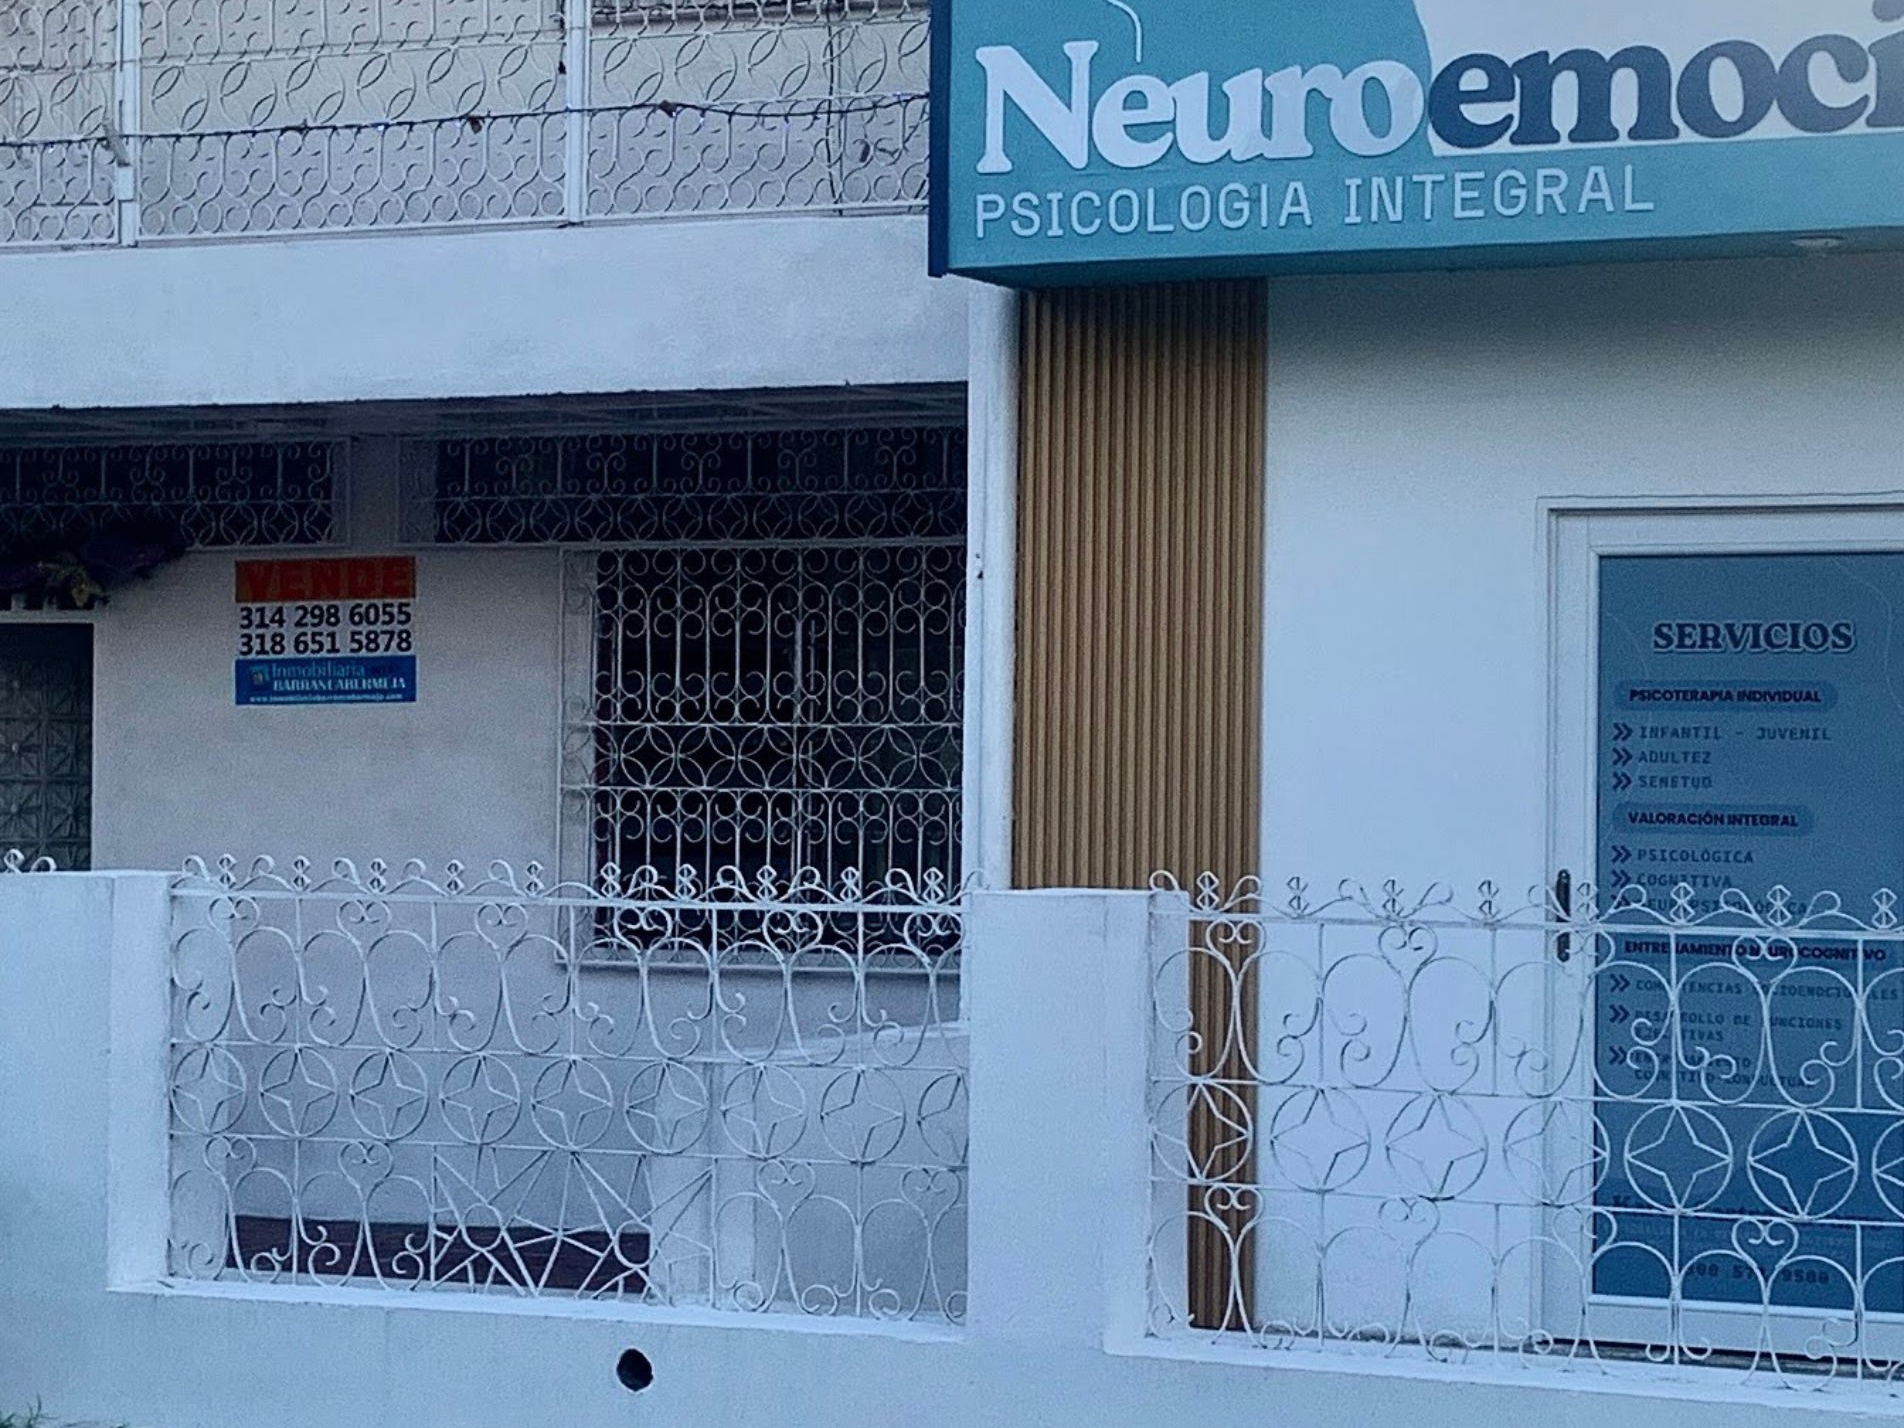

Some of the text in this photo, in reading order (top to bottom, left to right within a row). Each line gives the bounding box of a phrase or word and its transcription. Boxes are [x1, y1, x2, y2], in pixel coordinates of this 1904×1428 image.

[1342, 162, 1656, 227] INTEGRAL
[239, 601, 412, 630] 314 298 6055
[239, 628, 412, 657] 318 651 5878
[1653, 622, 1854, 651] SERVICIOS
[1629, 688, 1822, 703] PSICOTERAPIA INDIVIDUAL
[1639, 726, 1720, 740] INFANTIL
[1756, 727, 1831, 741] JUVENIL
[1638, 750, 1712, 764] ADULTEZ
[1628, 810, 1798, 828] VALORACIÓN INTEGRAL
[1625, 940, 1886, 961] ENTREAMIENTO NUROCOGNITVO
